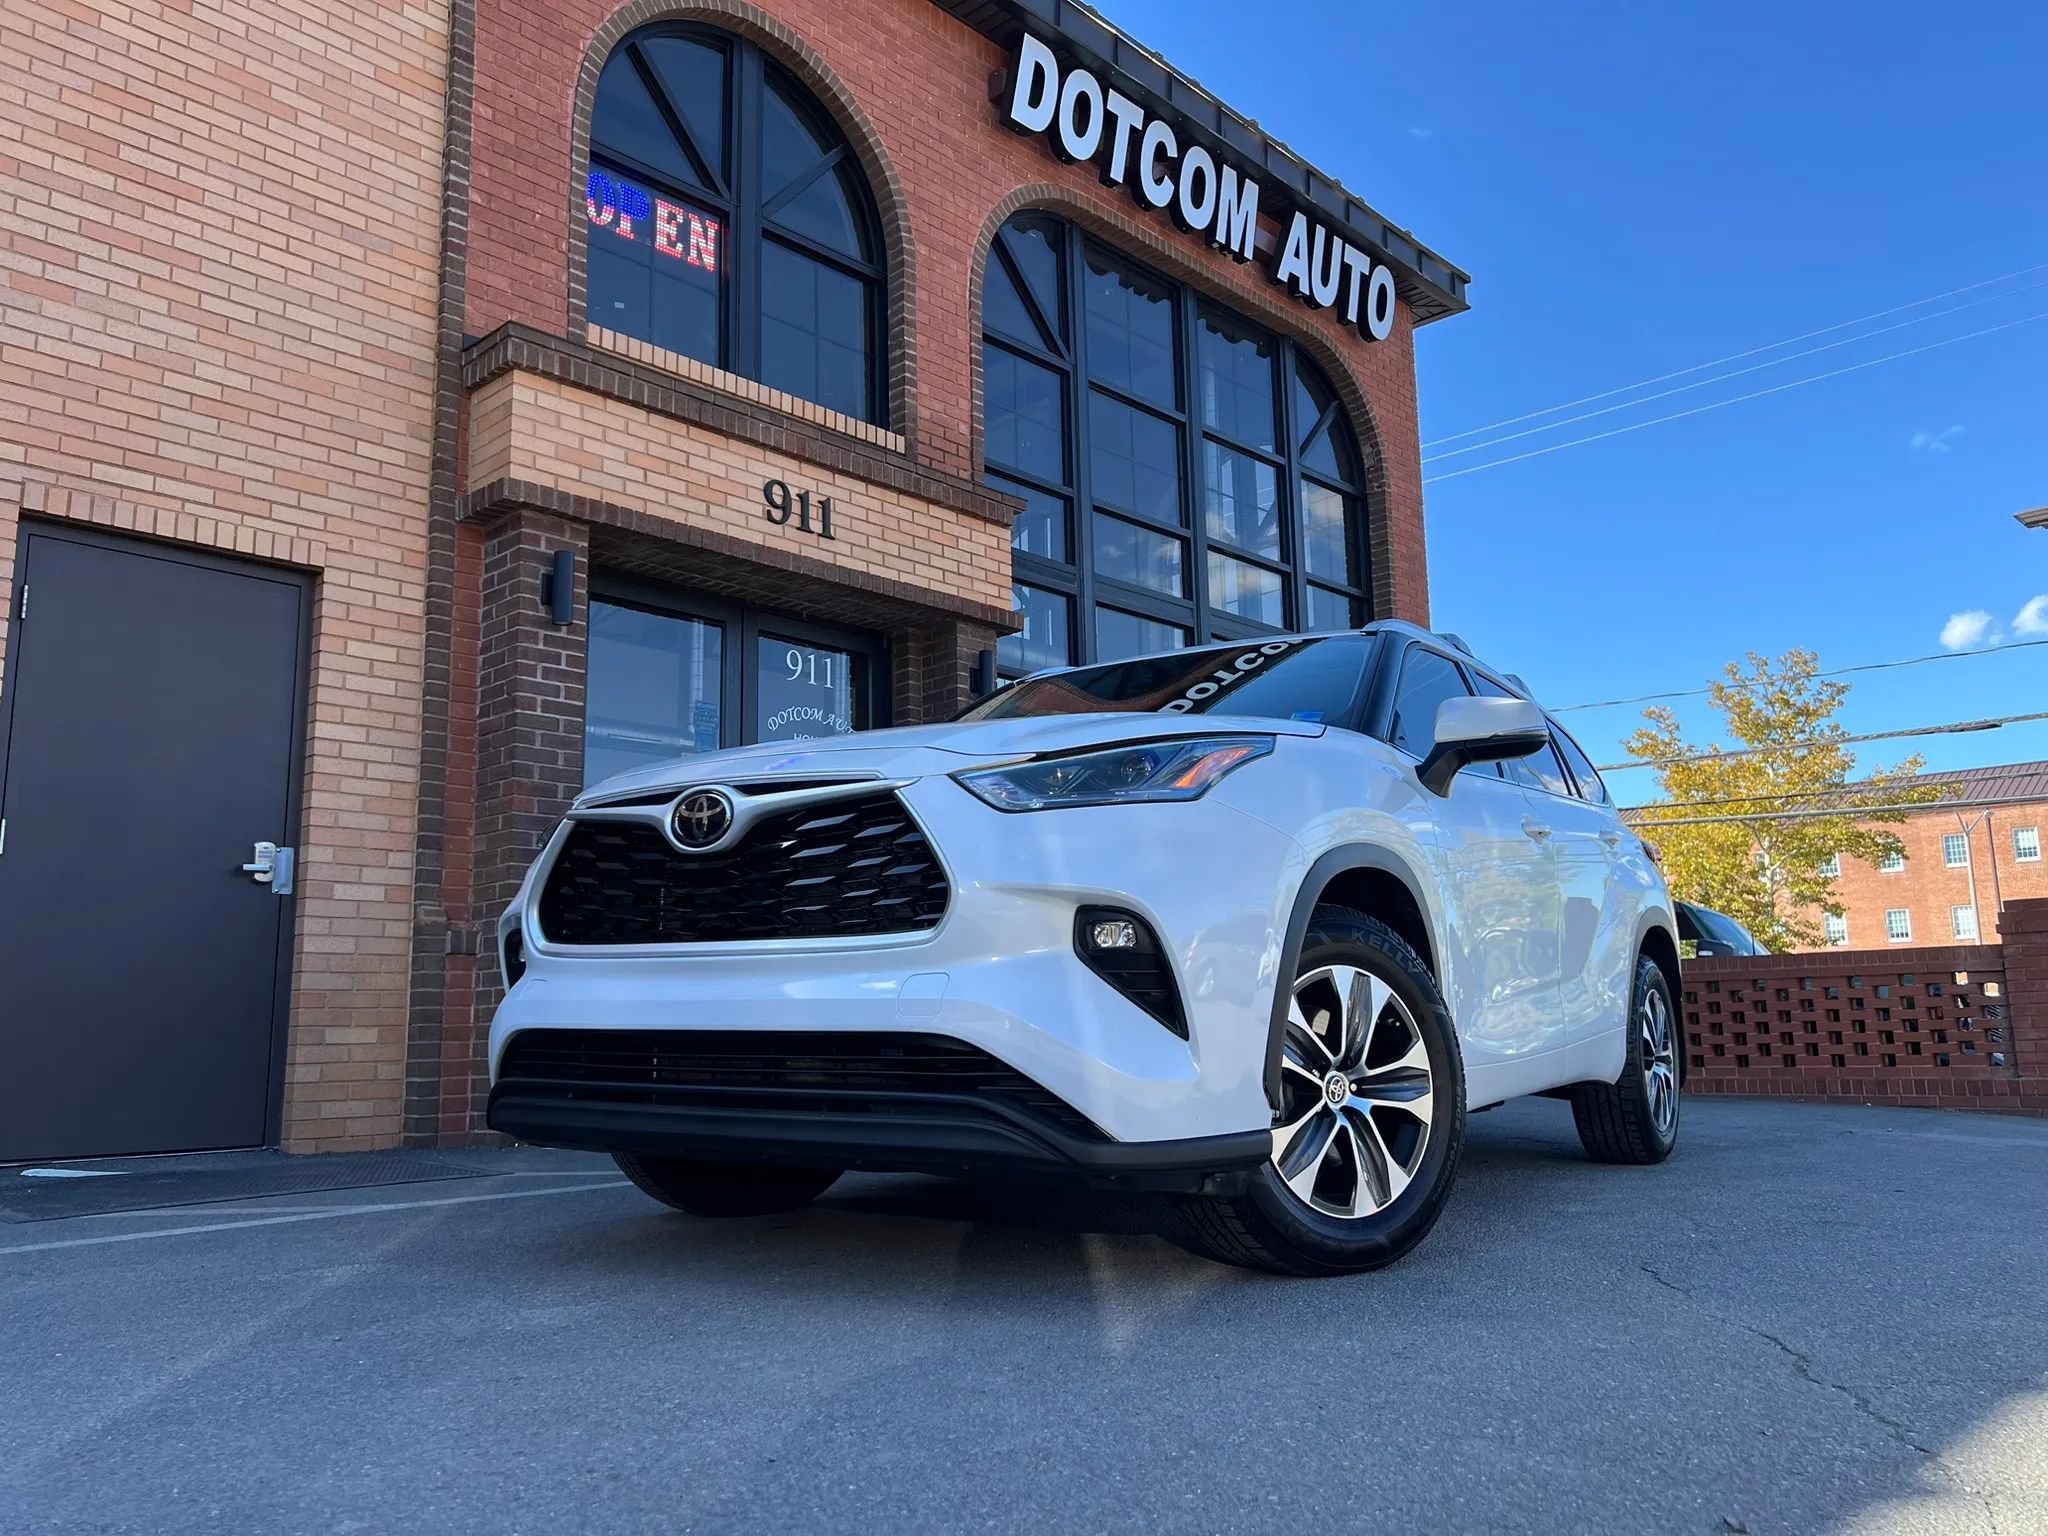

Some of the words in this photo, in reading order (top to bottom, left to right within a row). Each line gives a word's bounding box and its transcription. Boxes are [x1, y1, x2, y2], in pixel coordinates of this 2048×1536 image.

[1010, 32, 1259, 261] DOTCOM
[1277, 211, 1396, 341] AUTO
[587, 171, 720, 273] OPEN
[763, 479, 836, 541] 911
[786, 649, 834, 689] 911
[767, 705, 824, 732] DOTCOM
[822, 713, 857, 734] AUT
[1351, 927, 1420, 975] KELLY
